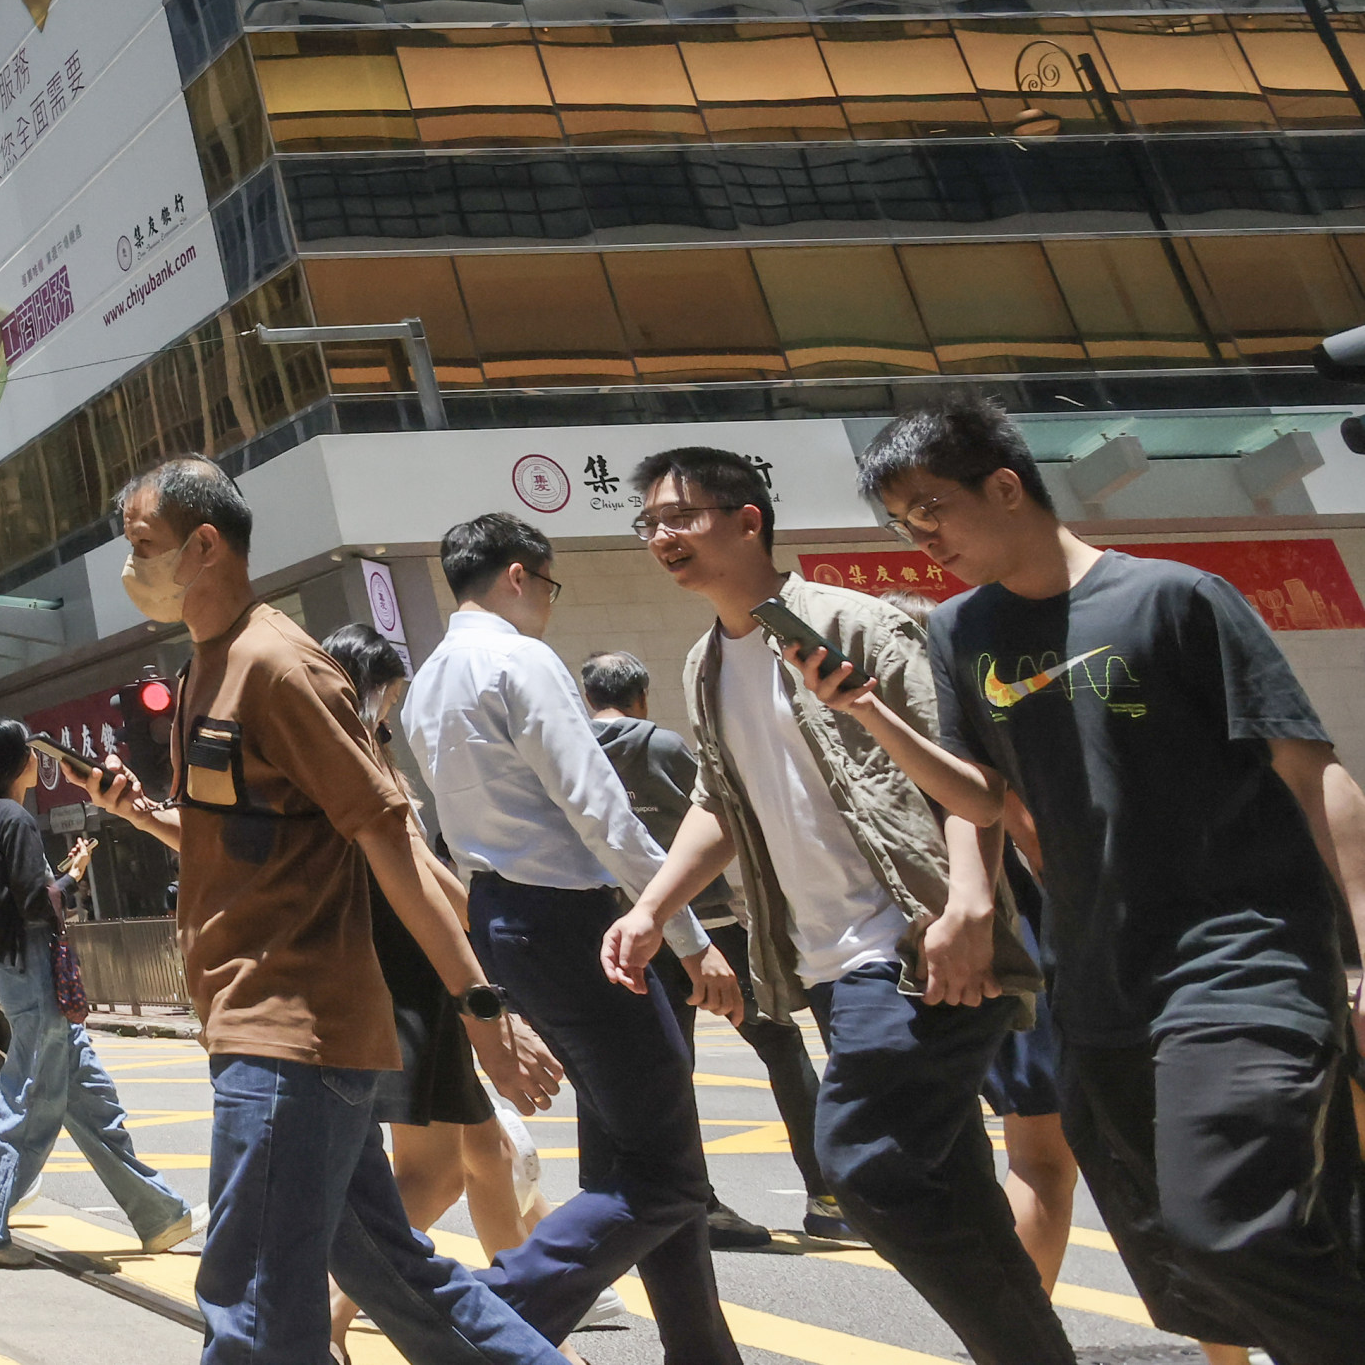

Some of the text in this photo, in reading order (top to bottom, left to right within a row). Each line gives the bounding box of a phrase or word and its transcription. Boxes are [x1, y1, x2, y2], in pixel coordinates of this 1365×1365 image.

[102, 244, 197, 327] www.chiyubank.com
[2, 270, 74, 363] 工商服務
[590, 497, 624, 511] Chiyu
[849, 564, 943, 584] 集友銀行
